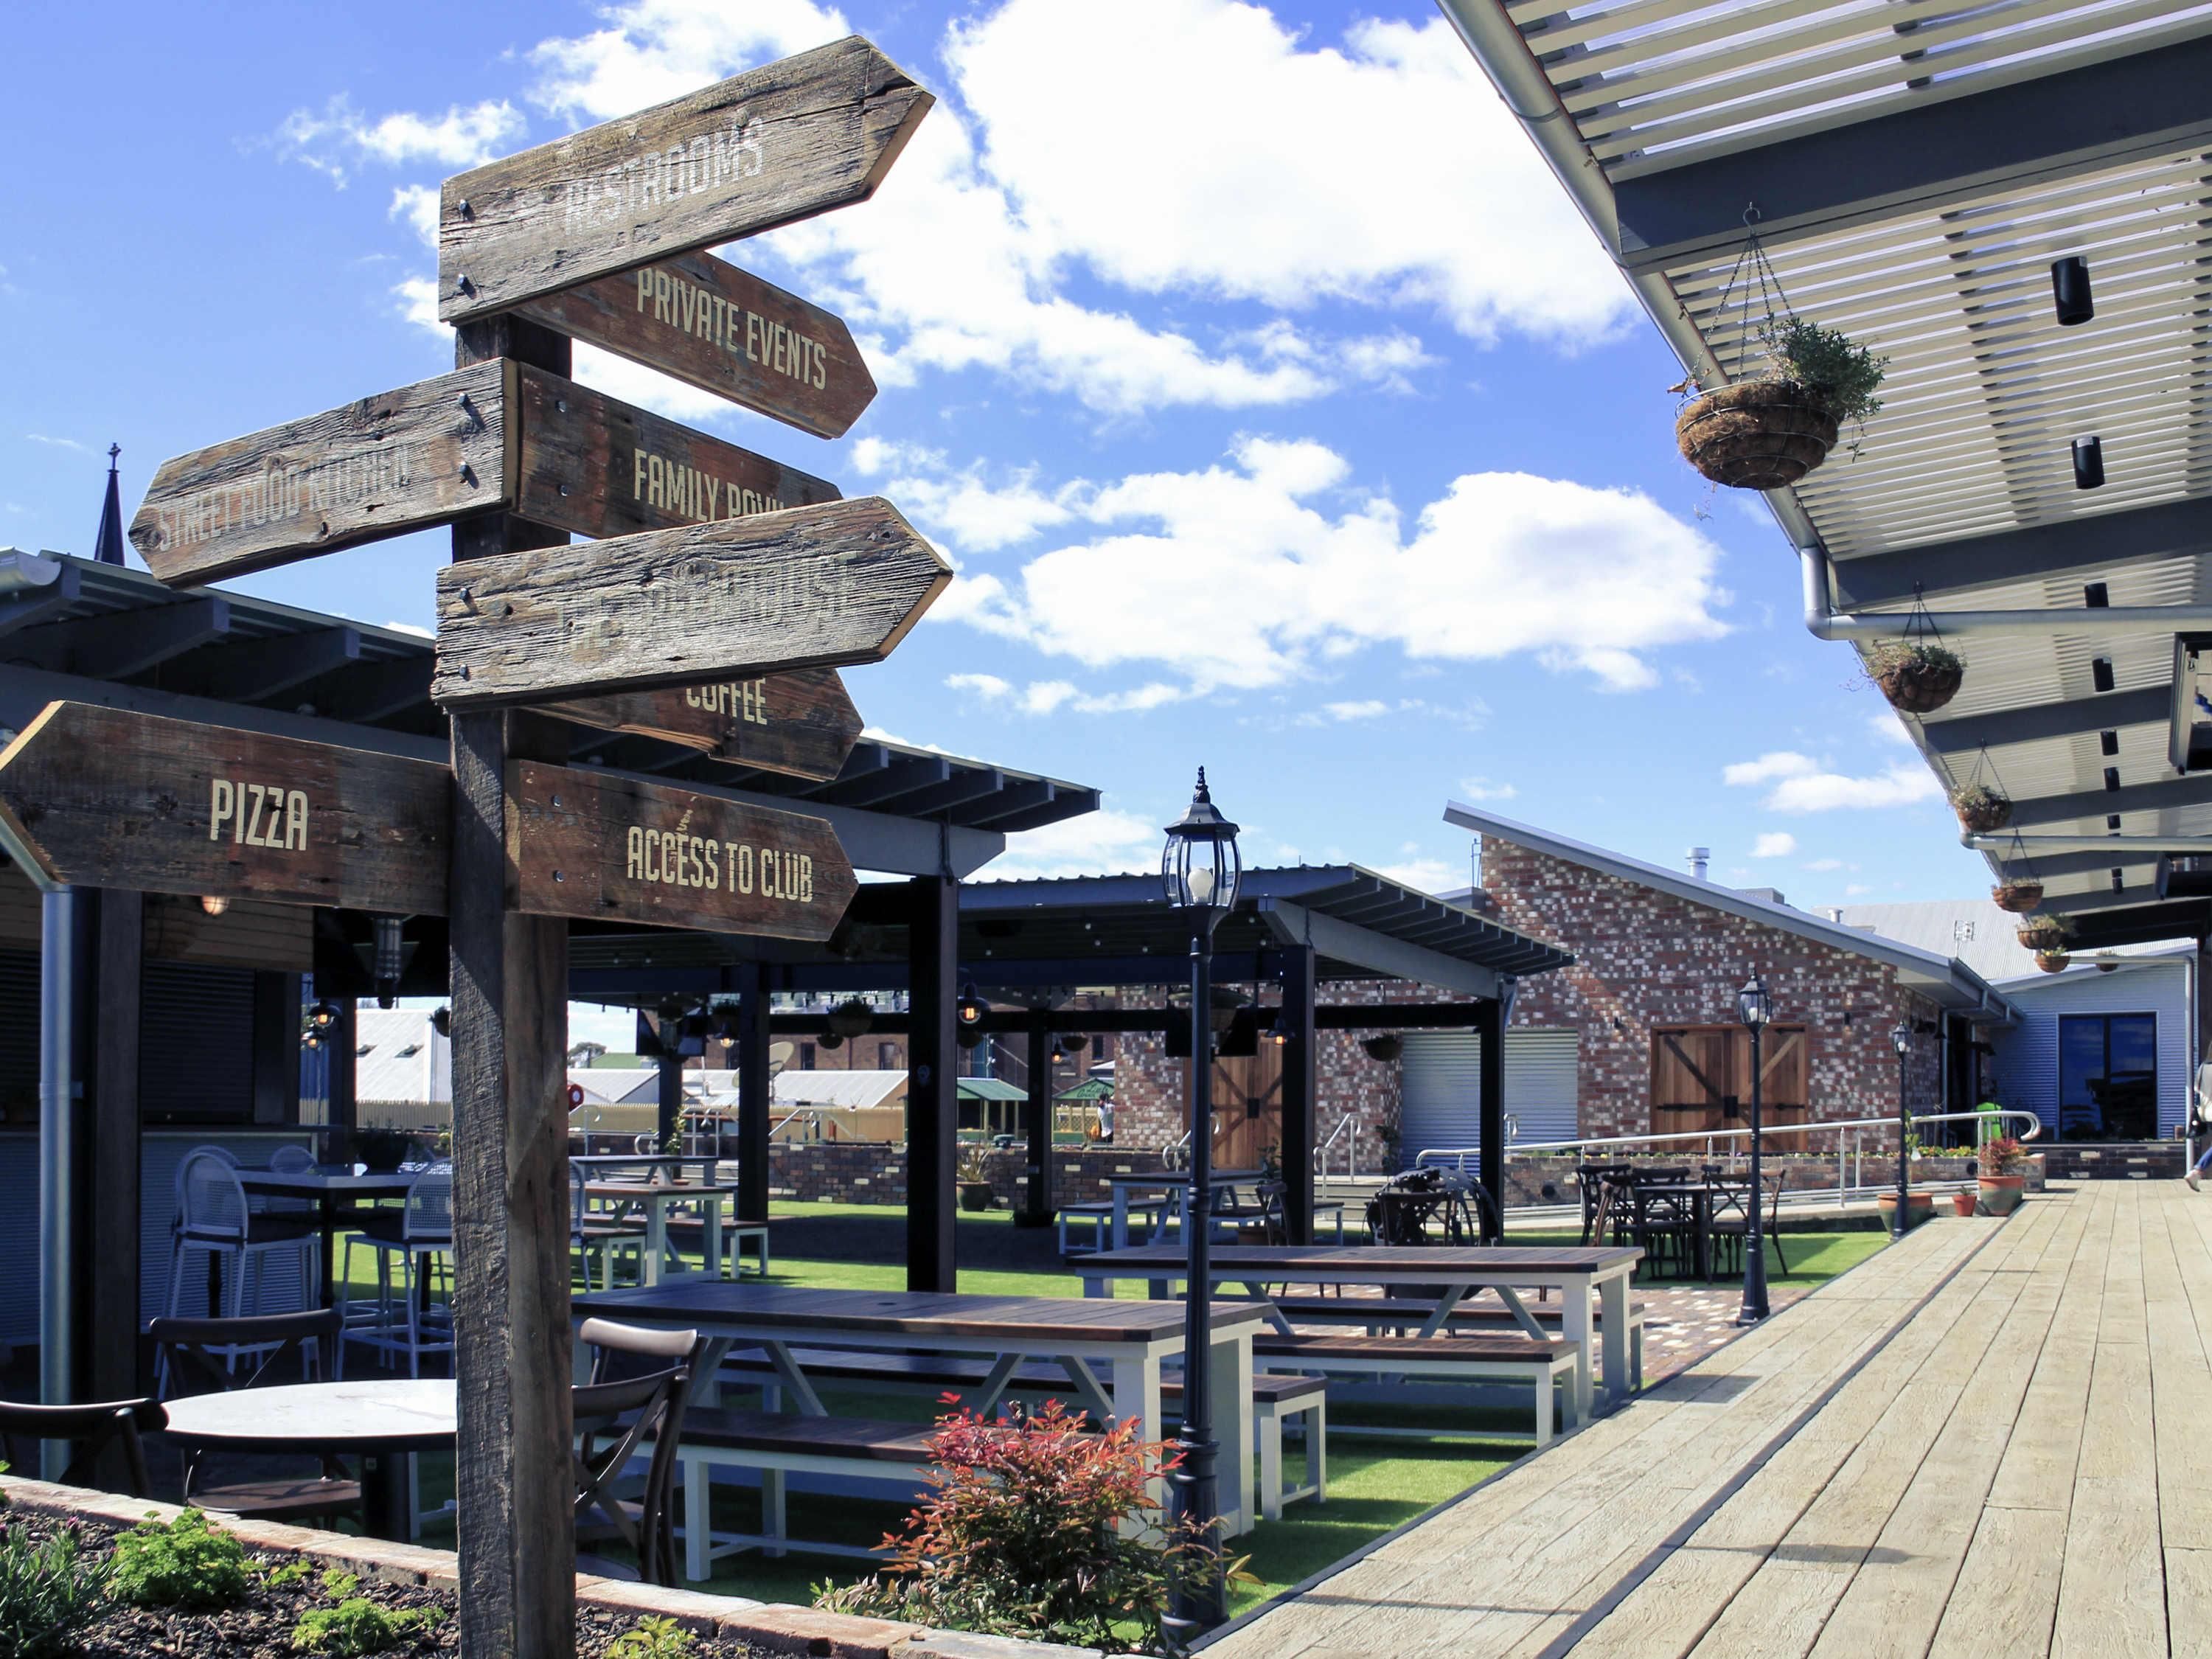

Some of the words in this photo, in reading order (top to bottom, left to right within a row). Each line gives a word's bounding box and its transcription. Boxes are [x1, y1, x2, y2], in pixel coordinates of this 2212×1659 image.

[566, 117, 763, 236] RESTROOMS
[637, 268, 739, 352] PRIVATE
[746, 311, 827, 390] EVENTS
[159, 490, 232, 552] STREET
[240, 465, 300, 533] FOOD
[308, 445, 411, 511] KITCHEN
[634, 448, 719, 522] FAMILY
[210, 779, 307, 851] PIZZA
[627, 826, 718, 890] ACCESS
[726, 842, 753, 895] TO
[760, 848, 813, 902] CLUB
